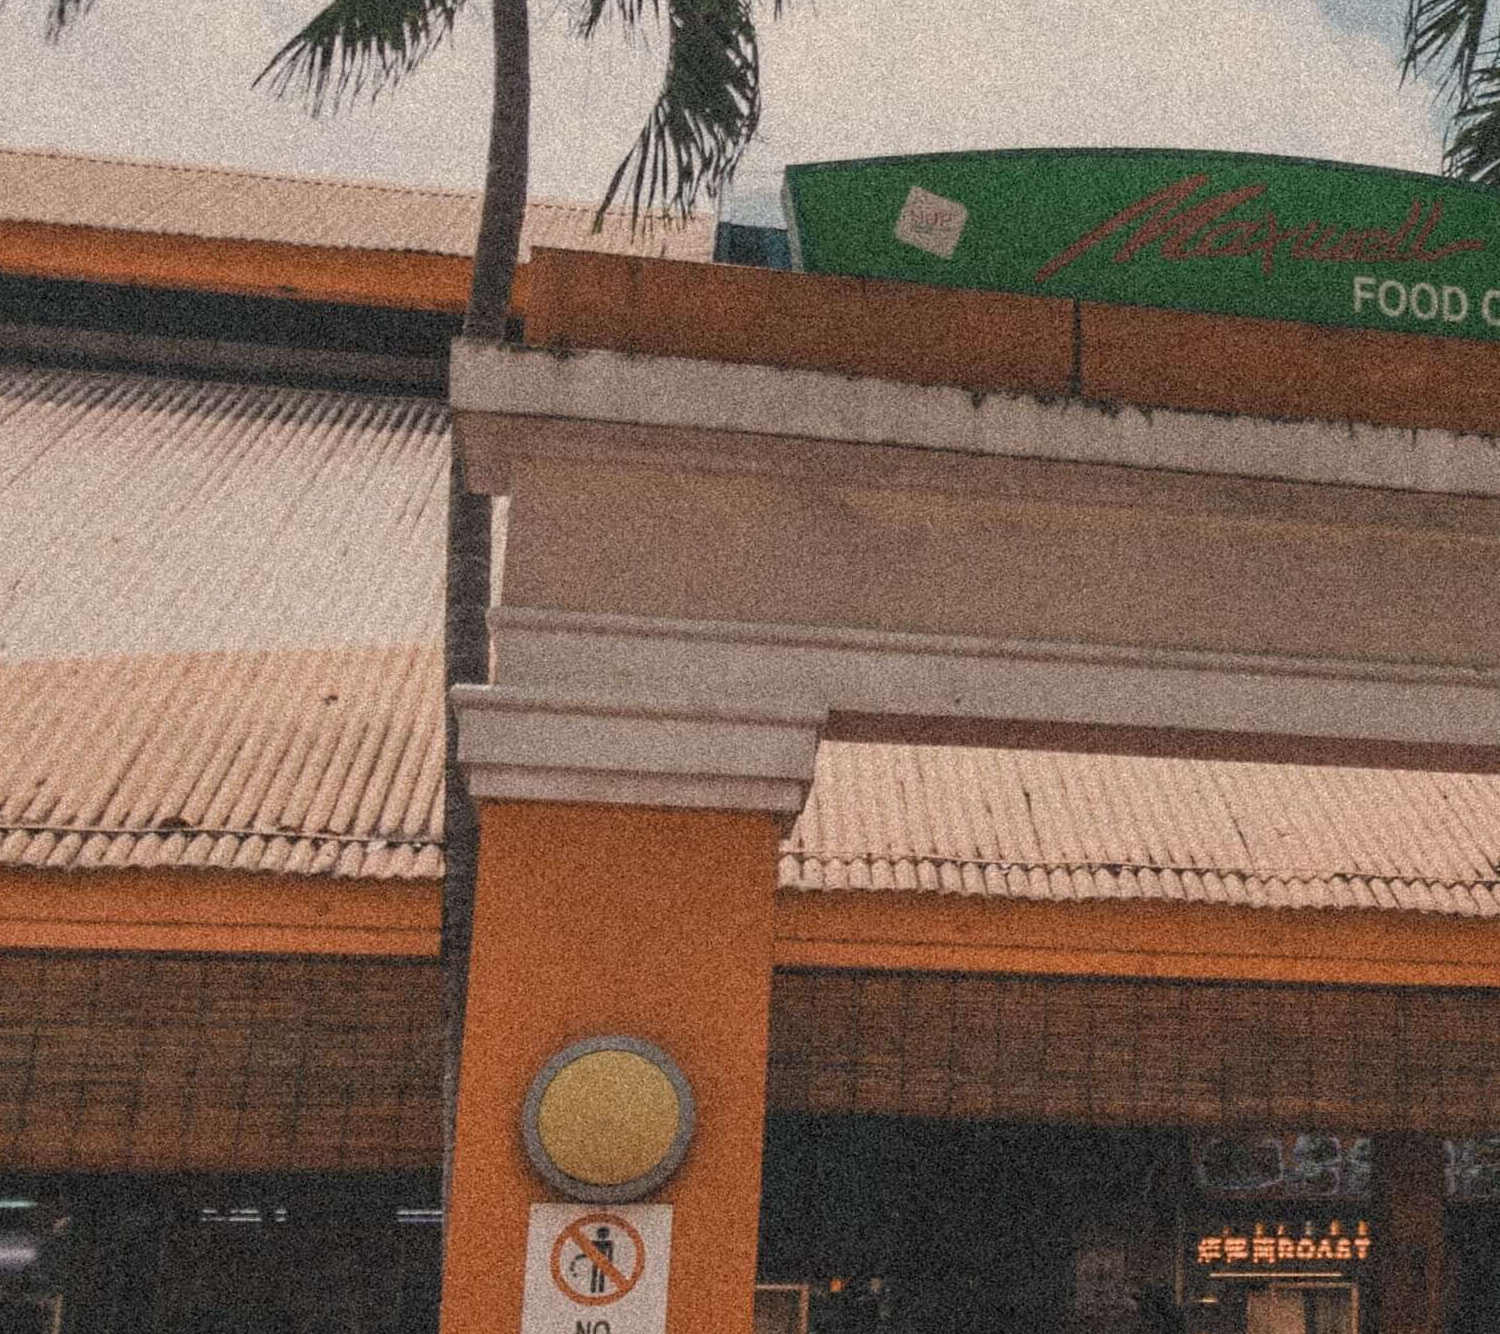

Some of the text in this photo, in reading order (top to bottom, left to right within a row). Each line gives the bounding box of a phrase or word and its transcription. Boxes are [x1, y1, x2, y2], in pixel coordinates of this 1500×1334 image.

[1033, 174, 1485, 283] Maxwell
[1352, 276, 1469, 323] FOOD
[1276, 1237, 1372, 1261] ROAST
